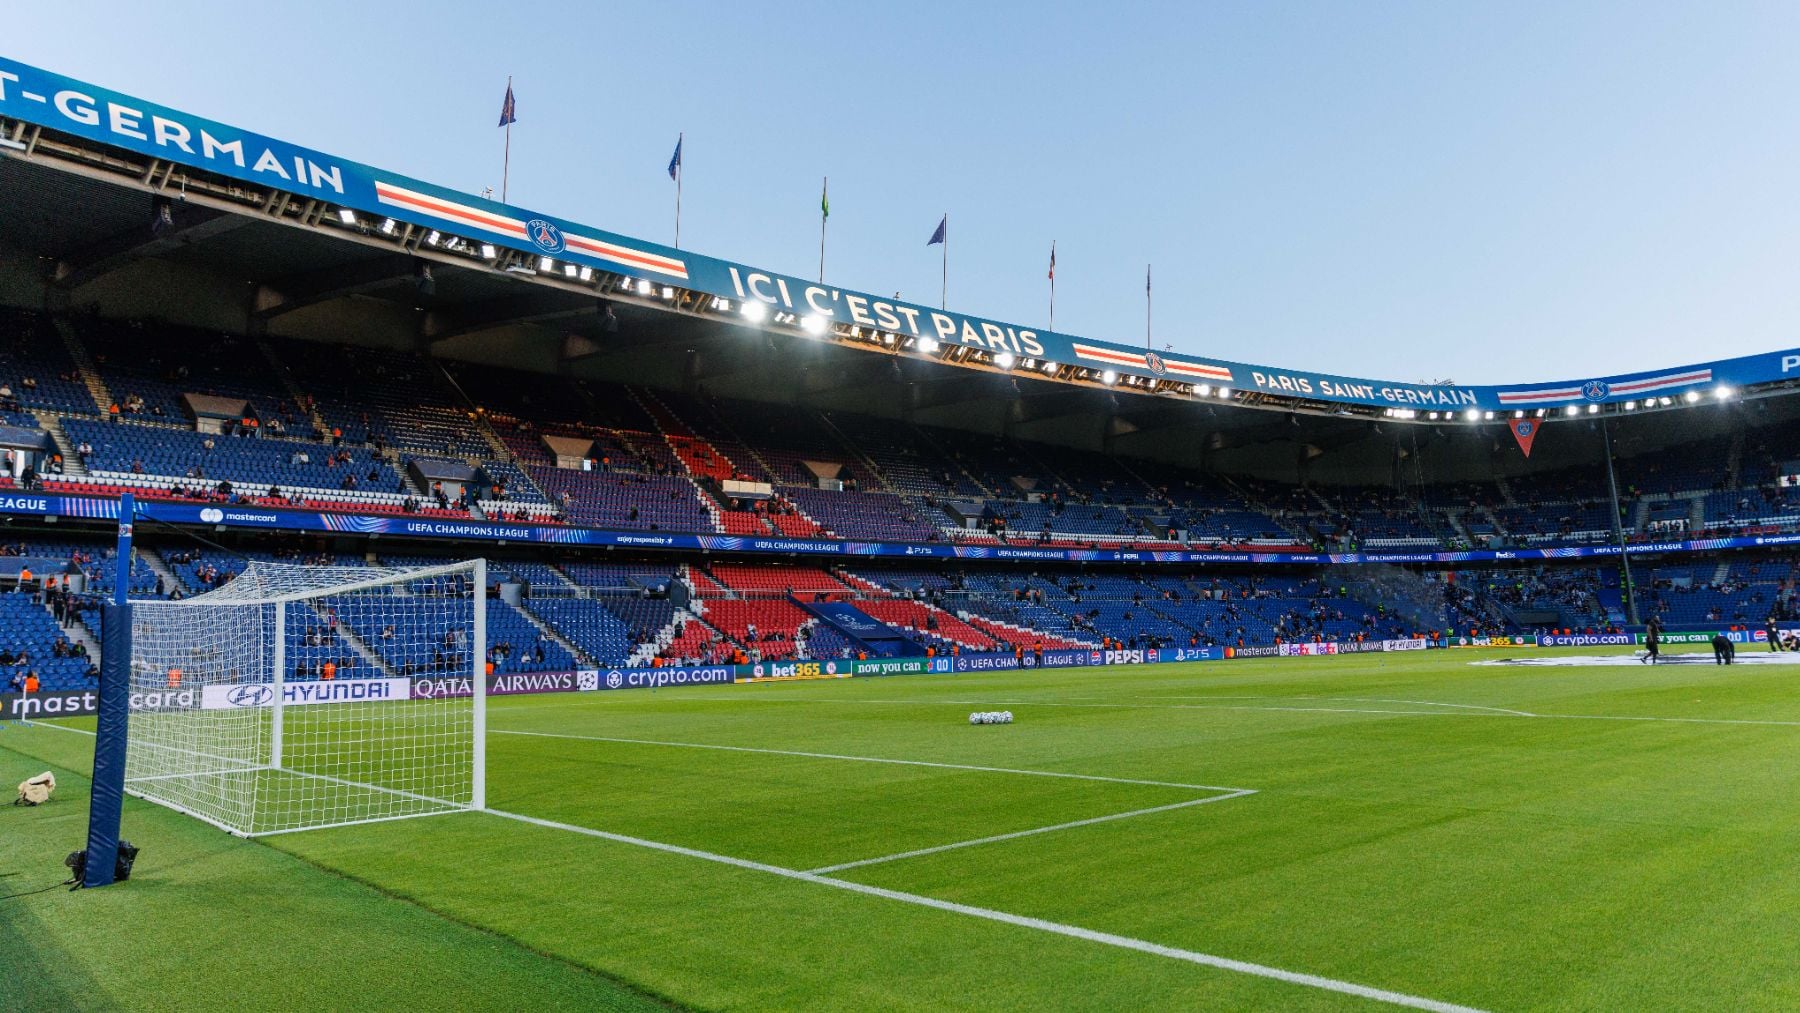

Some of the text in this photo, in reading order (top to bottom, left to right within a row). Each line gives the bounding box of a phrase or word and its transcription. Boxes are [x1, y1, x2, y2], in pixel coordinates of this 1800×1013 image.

[729, 267, 1044, 356] ICI C'EST PARIS
[1252, 372, 1478, 405] PARIS SAINT-GERMAIN
[226, 513, 277, 523] mastercard
[407, 523, 529, 538] UEFA CHAMPIONS LEAGUE
[755, 541, 840, 552] UEFA CHAMPIONS LEAGUE
[1612, 545, 1653, 553] CHMPIONS
[1654, 543, 1683, 551] LEAGUE
[1012, 550, 1043, 558] CHAMPIONS
[1044, 551, 1064, 559] LEAGUE
[1471, 636, 1511, 646] bet365
[1556, 634, 1628, 646] crypto.com
[1642, 634, 1709, 643] nw you can
[1186, 648, 1210, 659] PS5
[1236, 645, 1279, 656] mastercard
[1288, 642, 1336, 655] FedEx FedEx
[971, 655, 1073, 669] UEFA CHAMION LEAGUE
[1105, 649, 1144, 665] PEPSI
[771, 662, 820, 677] bet365
[857, 661, 921, 675] now you can
[628, 666, 727, 688] crypto.com
[282, 682, 389, 701] HYUNDAI
[415, 674, 572, 698] QATA AIRWAYS
[12, 689, 194, 714] mastcard
